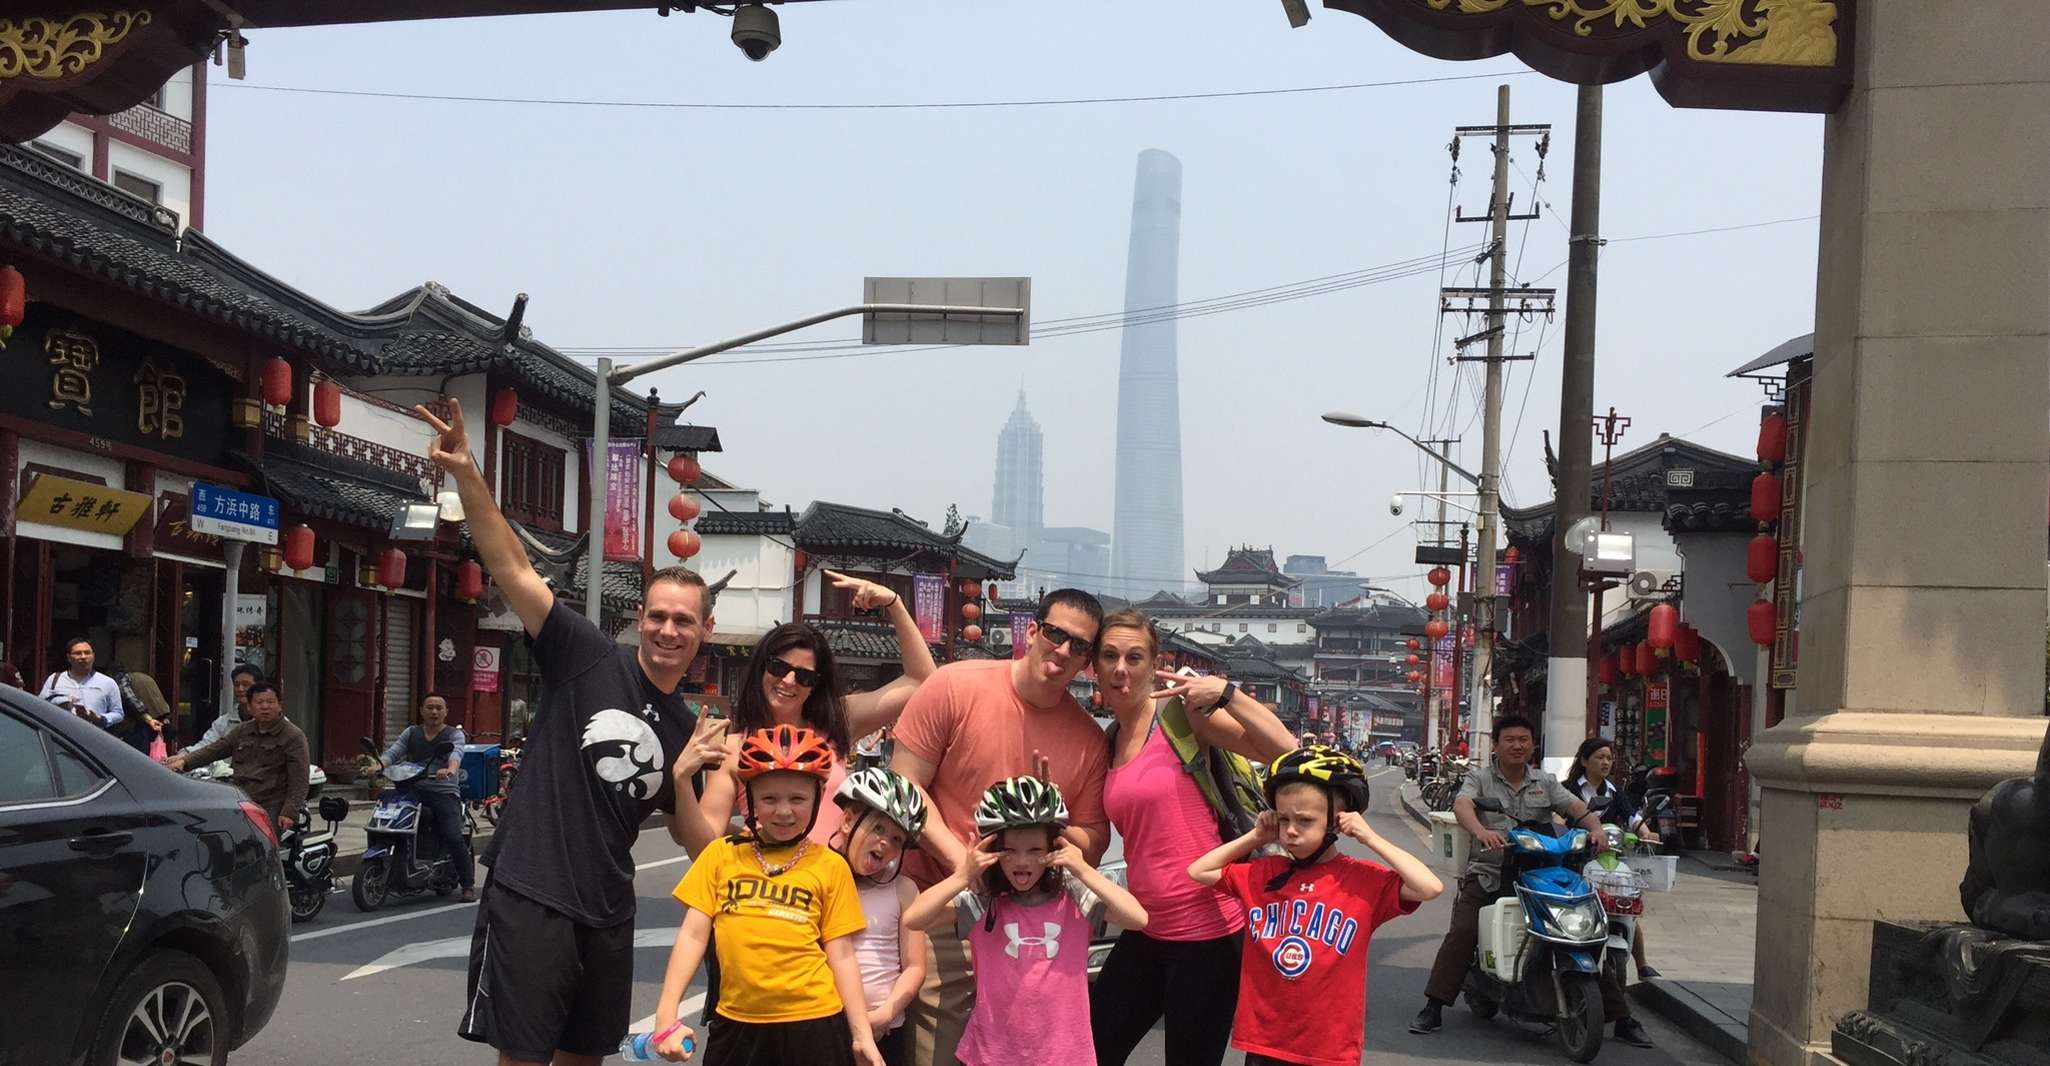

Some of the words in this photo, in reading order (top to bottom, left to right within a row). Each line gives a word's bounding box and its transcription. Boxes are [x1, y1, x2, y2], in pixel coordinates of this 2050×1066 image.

[214, 494, 261, 521] 方浜中路
[196, 519, 205, 529] W
[727, 879, 814, 911] IOWA
[1249, 899, 1358, 956] CHICAGO
